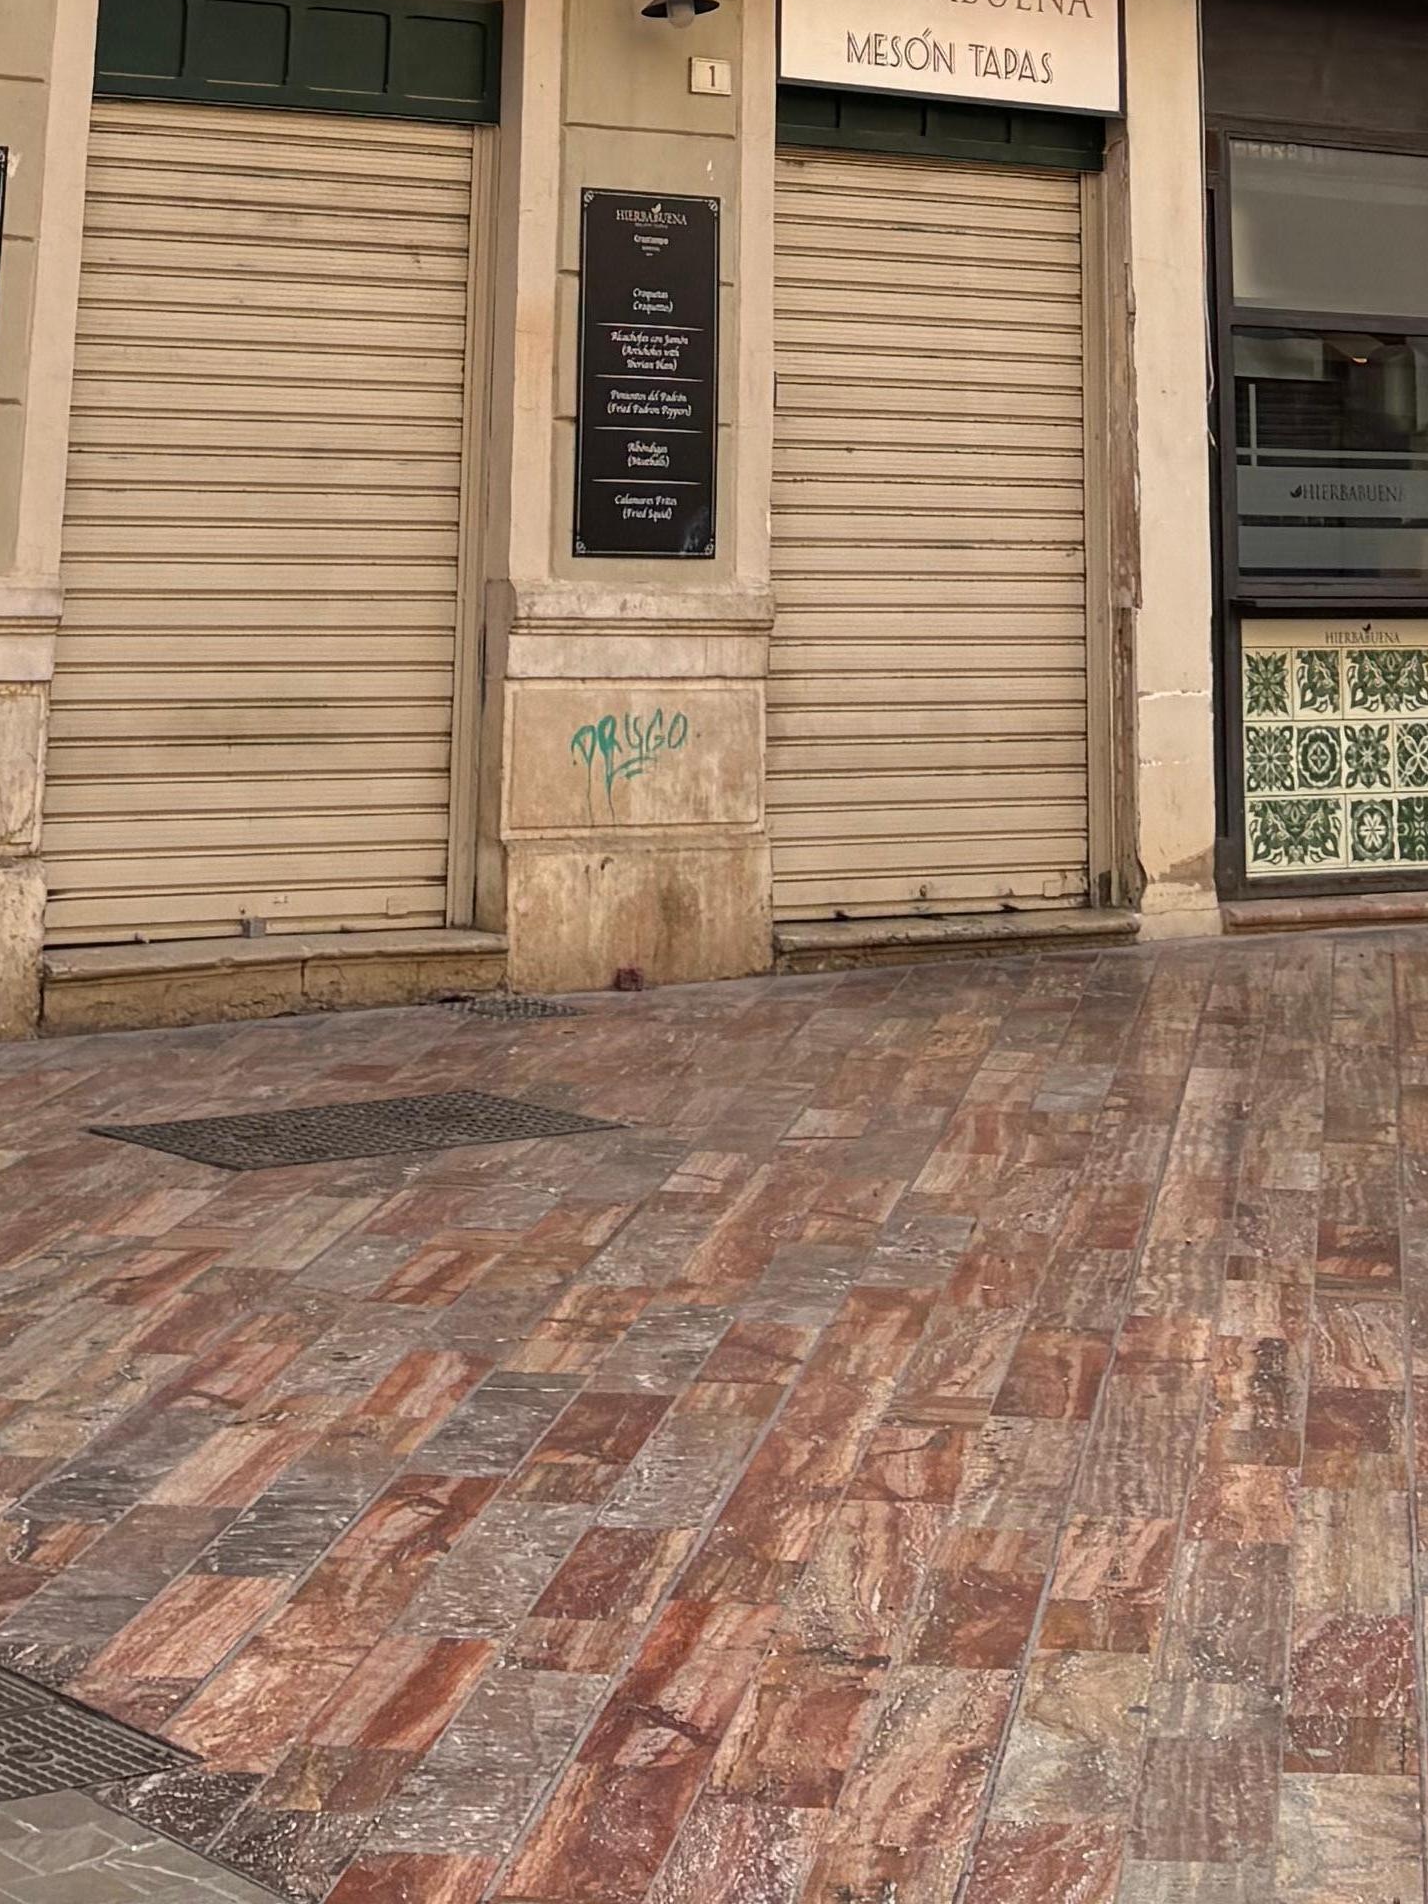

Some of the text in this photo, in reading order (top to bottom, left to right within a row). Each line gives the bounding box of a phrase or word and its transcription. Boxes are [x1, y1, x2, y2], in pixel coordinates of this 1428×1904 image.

[847, 27, 1054, 85] MESÓN TAPAS
[708, 64, 716, 88] 1
[616, 209, 688, 226] HIERBABUENA
